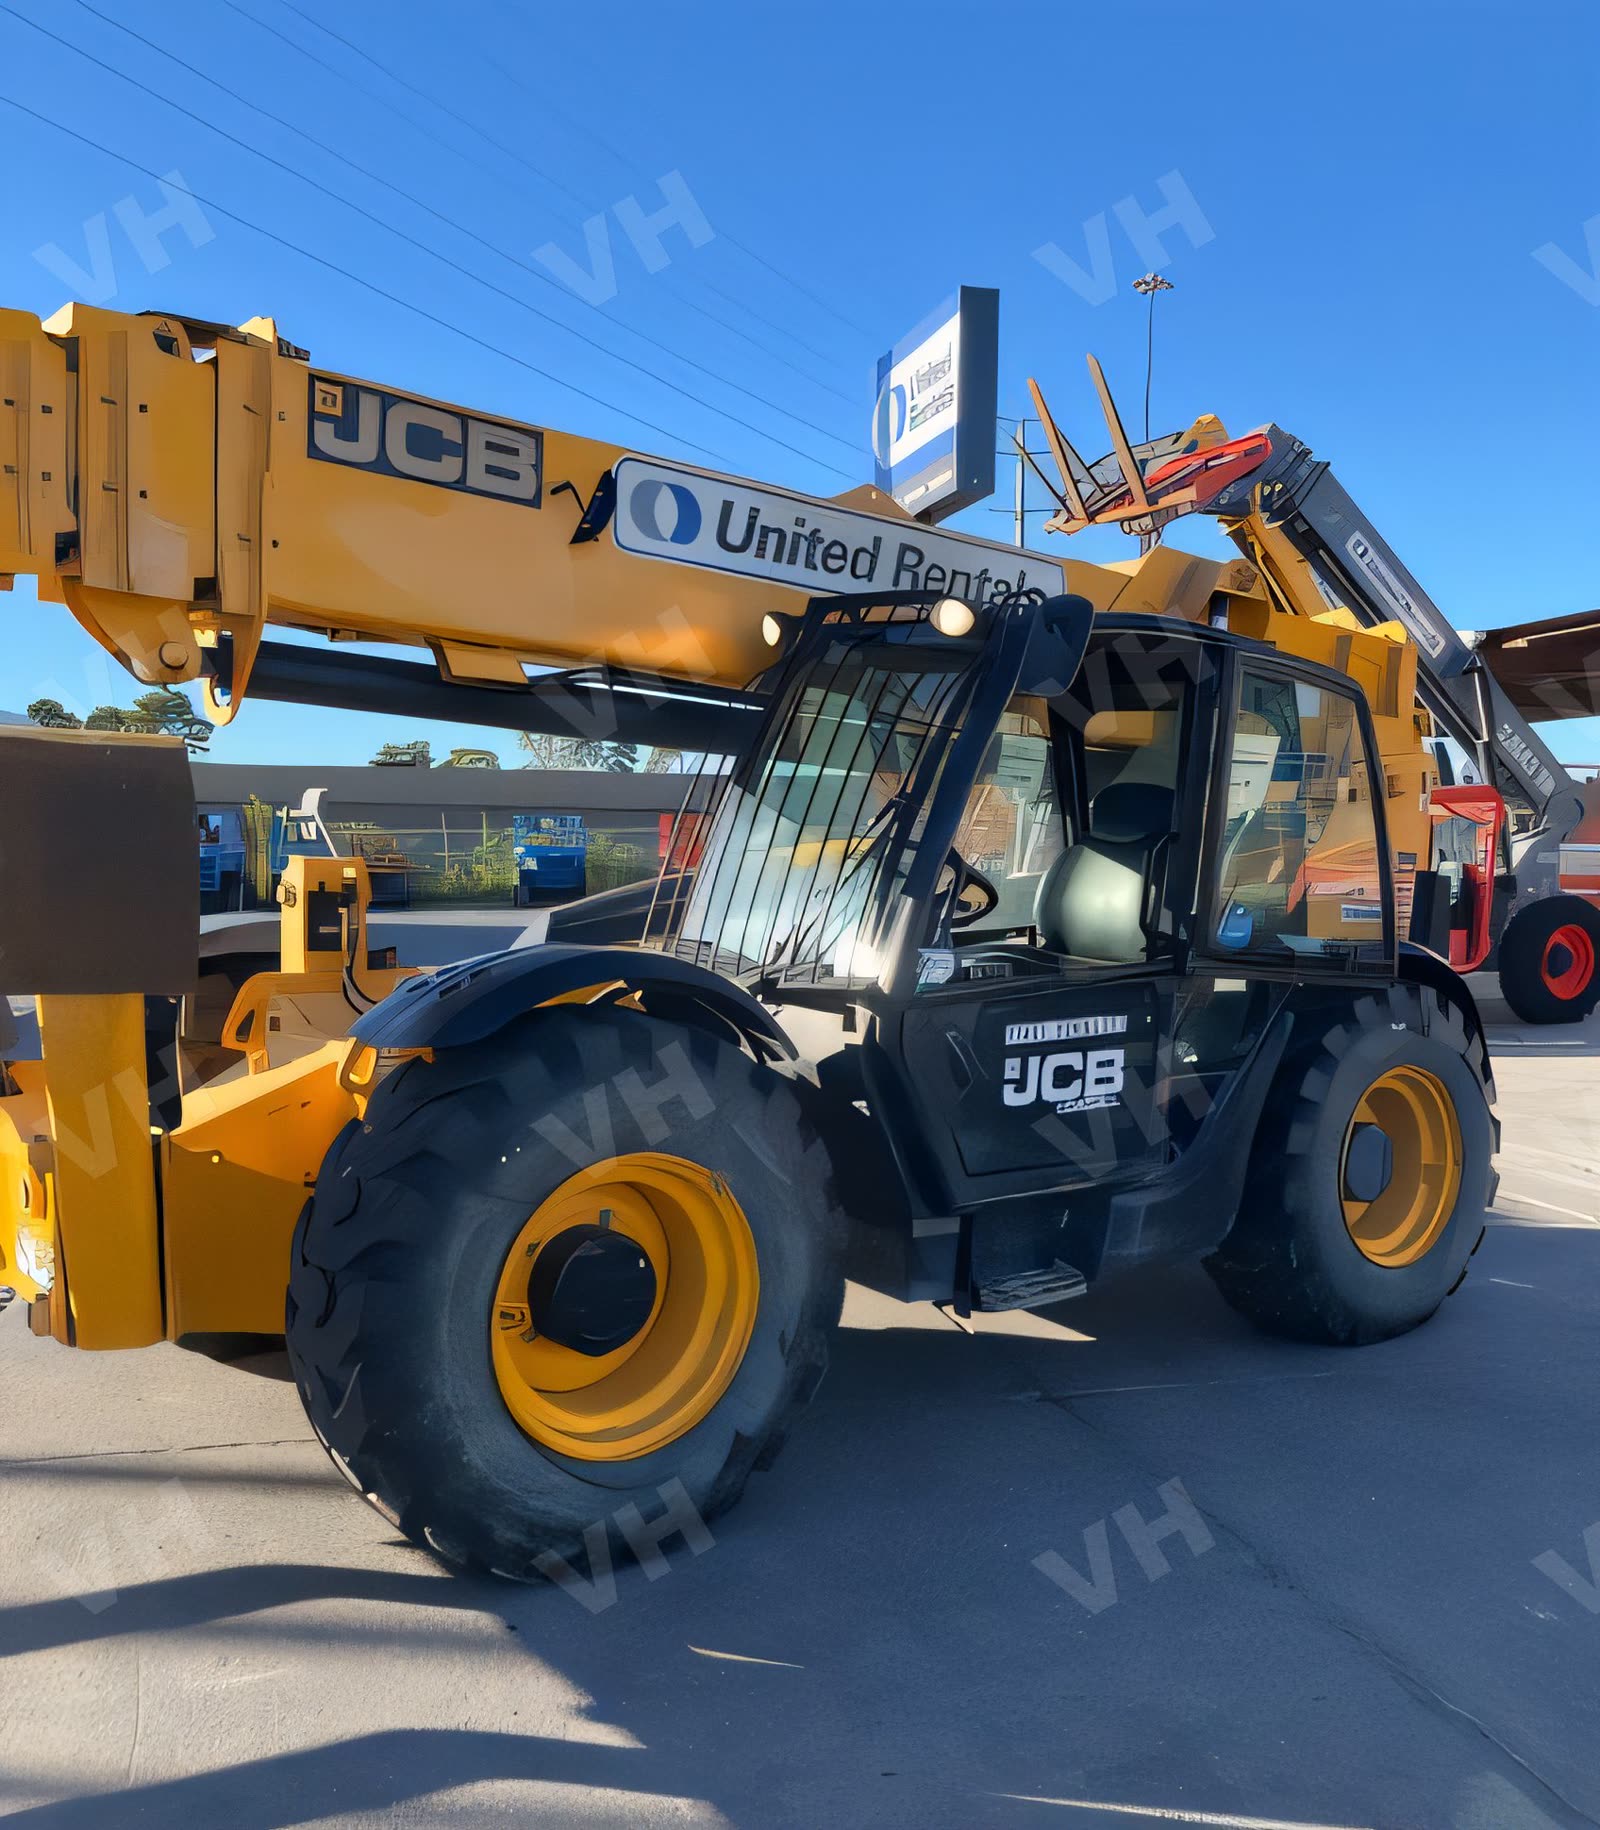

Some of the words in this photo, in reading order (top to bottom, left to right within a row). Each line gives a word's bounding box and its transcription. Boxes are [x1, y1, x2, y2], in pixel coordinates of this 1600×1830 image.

[313, 386, 538, 501] JCB
[716, 499, 882, 583] United
[891, 541, 1047, 608] Rental
[1003, 1049, 1125, 1107] JCB
